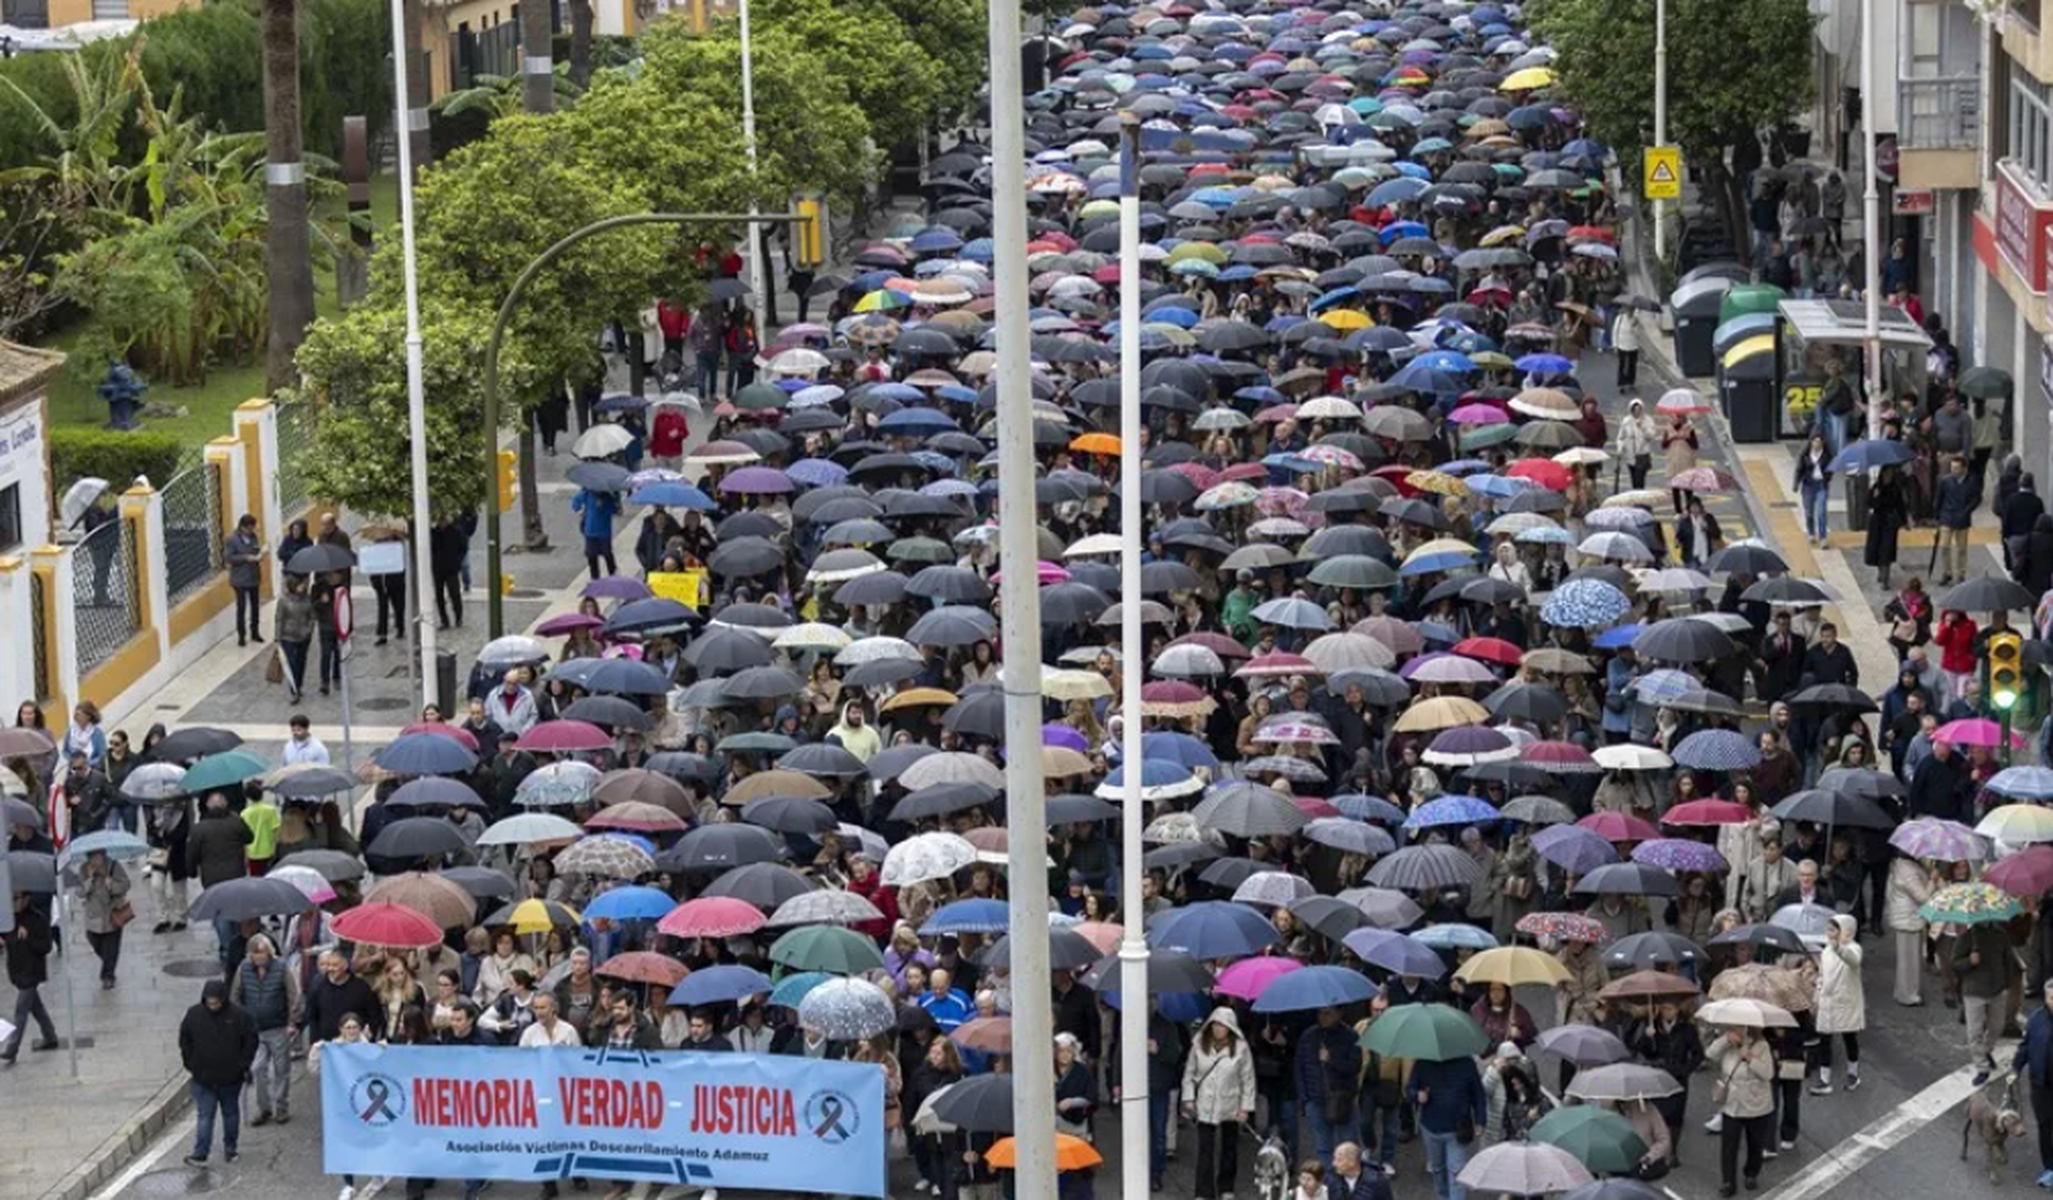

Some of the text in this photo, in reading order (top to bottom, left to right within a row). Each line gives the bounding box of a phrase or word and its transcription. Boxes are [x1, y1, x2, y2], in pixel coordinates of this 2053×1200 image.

[413, 1078, 538, 1128] MEMORIA
[558, 1077, 664, 1129] VERDAD
[690, 1084, 797, 1137] JUSTICIA
[446, 1140, 523, 1153] Asociación
[712, 1148, 769, 1161] Adamuz
